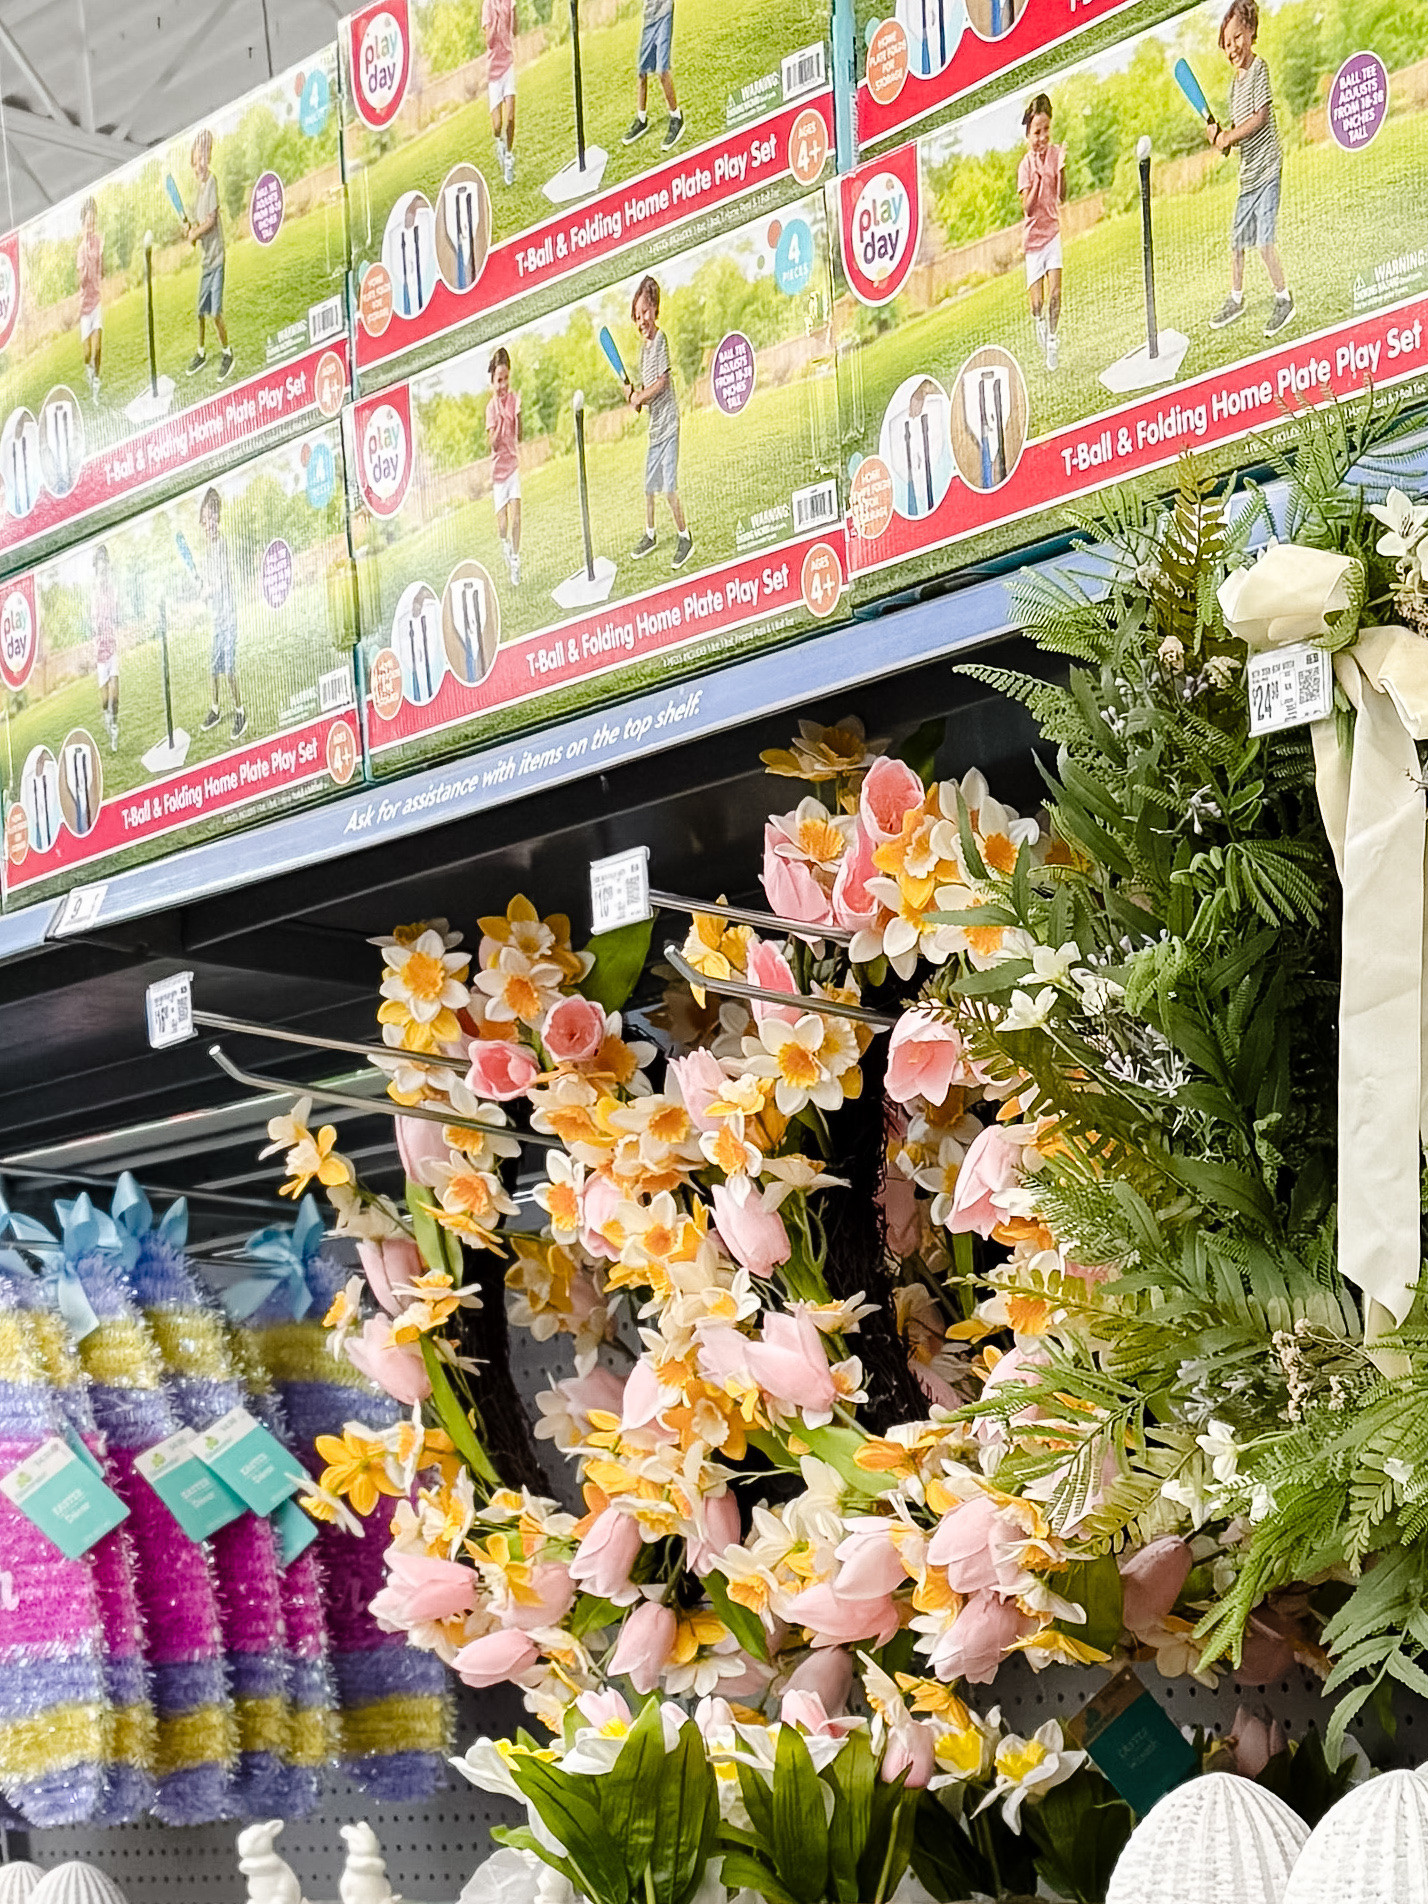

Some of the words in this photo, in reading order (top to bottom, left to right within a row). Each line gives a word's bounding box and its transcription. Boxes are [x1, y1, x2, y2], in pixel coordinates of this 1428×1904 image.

[365, 28, 398, 75] play
[367, 60, 397, 95] day
[796, 139, 823, 173] 4+
[515, 246, 555, 279] T-Ball
[555, 236, 569, 260] &
[569, 210, 623, 259] Folding
[624, 193, 670, 233] Home
[671, 169, 713, 211] Plate
[713, 150, 750, 194] Play
[750, 132, 778, 171] Set
[859, 194, 903, 243] play
[789, 233, 800, 263] 4
[864, 230, 900, 265] day
[1060, 432, 1114, 477] T-Ball
[1116, 427, 1133, 456] &
[1135, 395, 1208, 446] Folding
[1212, 376, 1274, 422] Home
[1277, 358, 1333, 400] Plate
[1336, 338, 1381, 380] Play
[1387, 319, 1423, 360] Set
[369, 422, 400, 462] play
[372, 450, 400, 486] day
[808, 571, 836, 605] 4+
[526, 645, 566, 678] T-Ball
[566, 638, 580, 663] &
[581, 617, 635, 661] Folding
[636, 605, 682, 641] Home
[683, 588, 724, 627] Plate
[725, 575, 761, 615] Play
[762, 562, 790, 596] Set
[6, 634, 27, 660] day
[121, 802, 151, 830] T-Ball
[152, 801, 162, 820] &
[164, 785, 204, 816] Folding
[204, 772, 239, 799] Home
[240, 760, 270, 788] Plate
[271, 749, 297, 780] Play
[298, 739, 319, 765] Set
[343, 808, 375, 835] Ask
[375, 798, 402, 832] for
[401, 773, 480, 818] assistance
[481, 756, 517, 788] with
[517, 743, 563, 779] items
[565, 737, 590, 757] on
[591, 722, 621, 751] the
[621, 711, 654, 749] top
